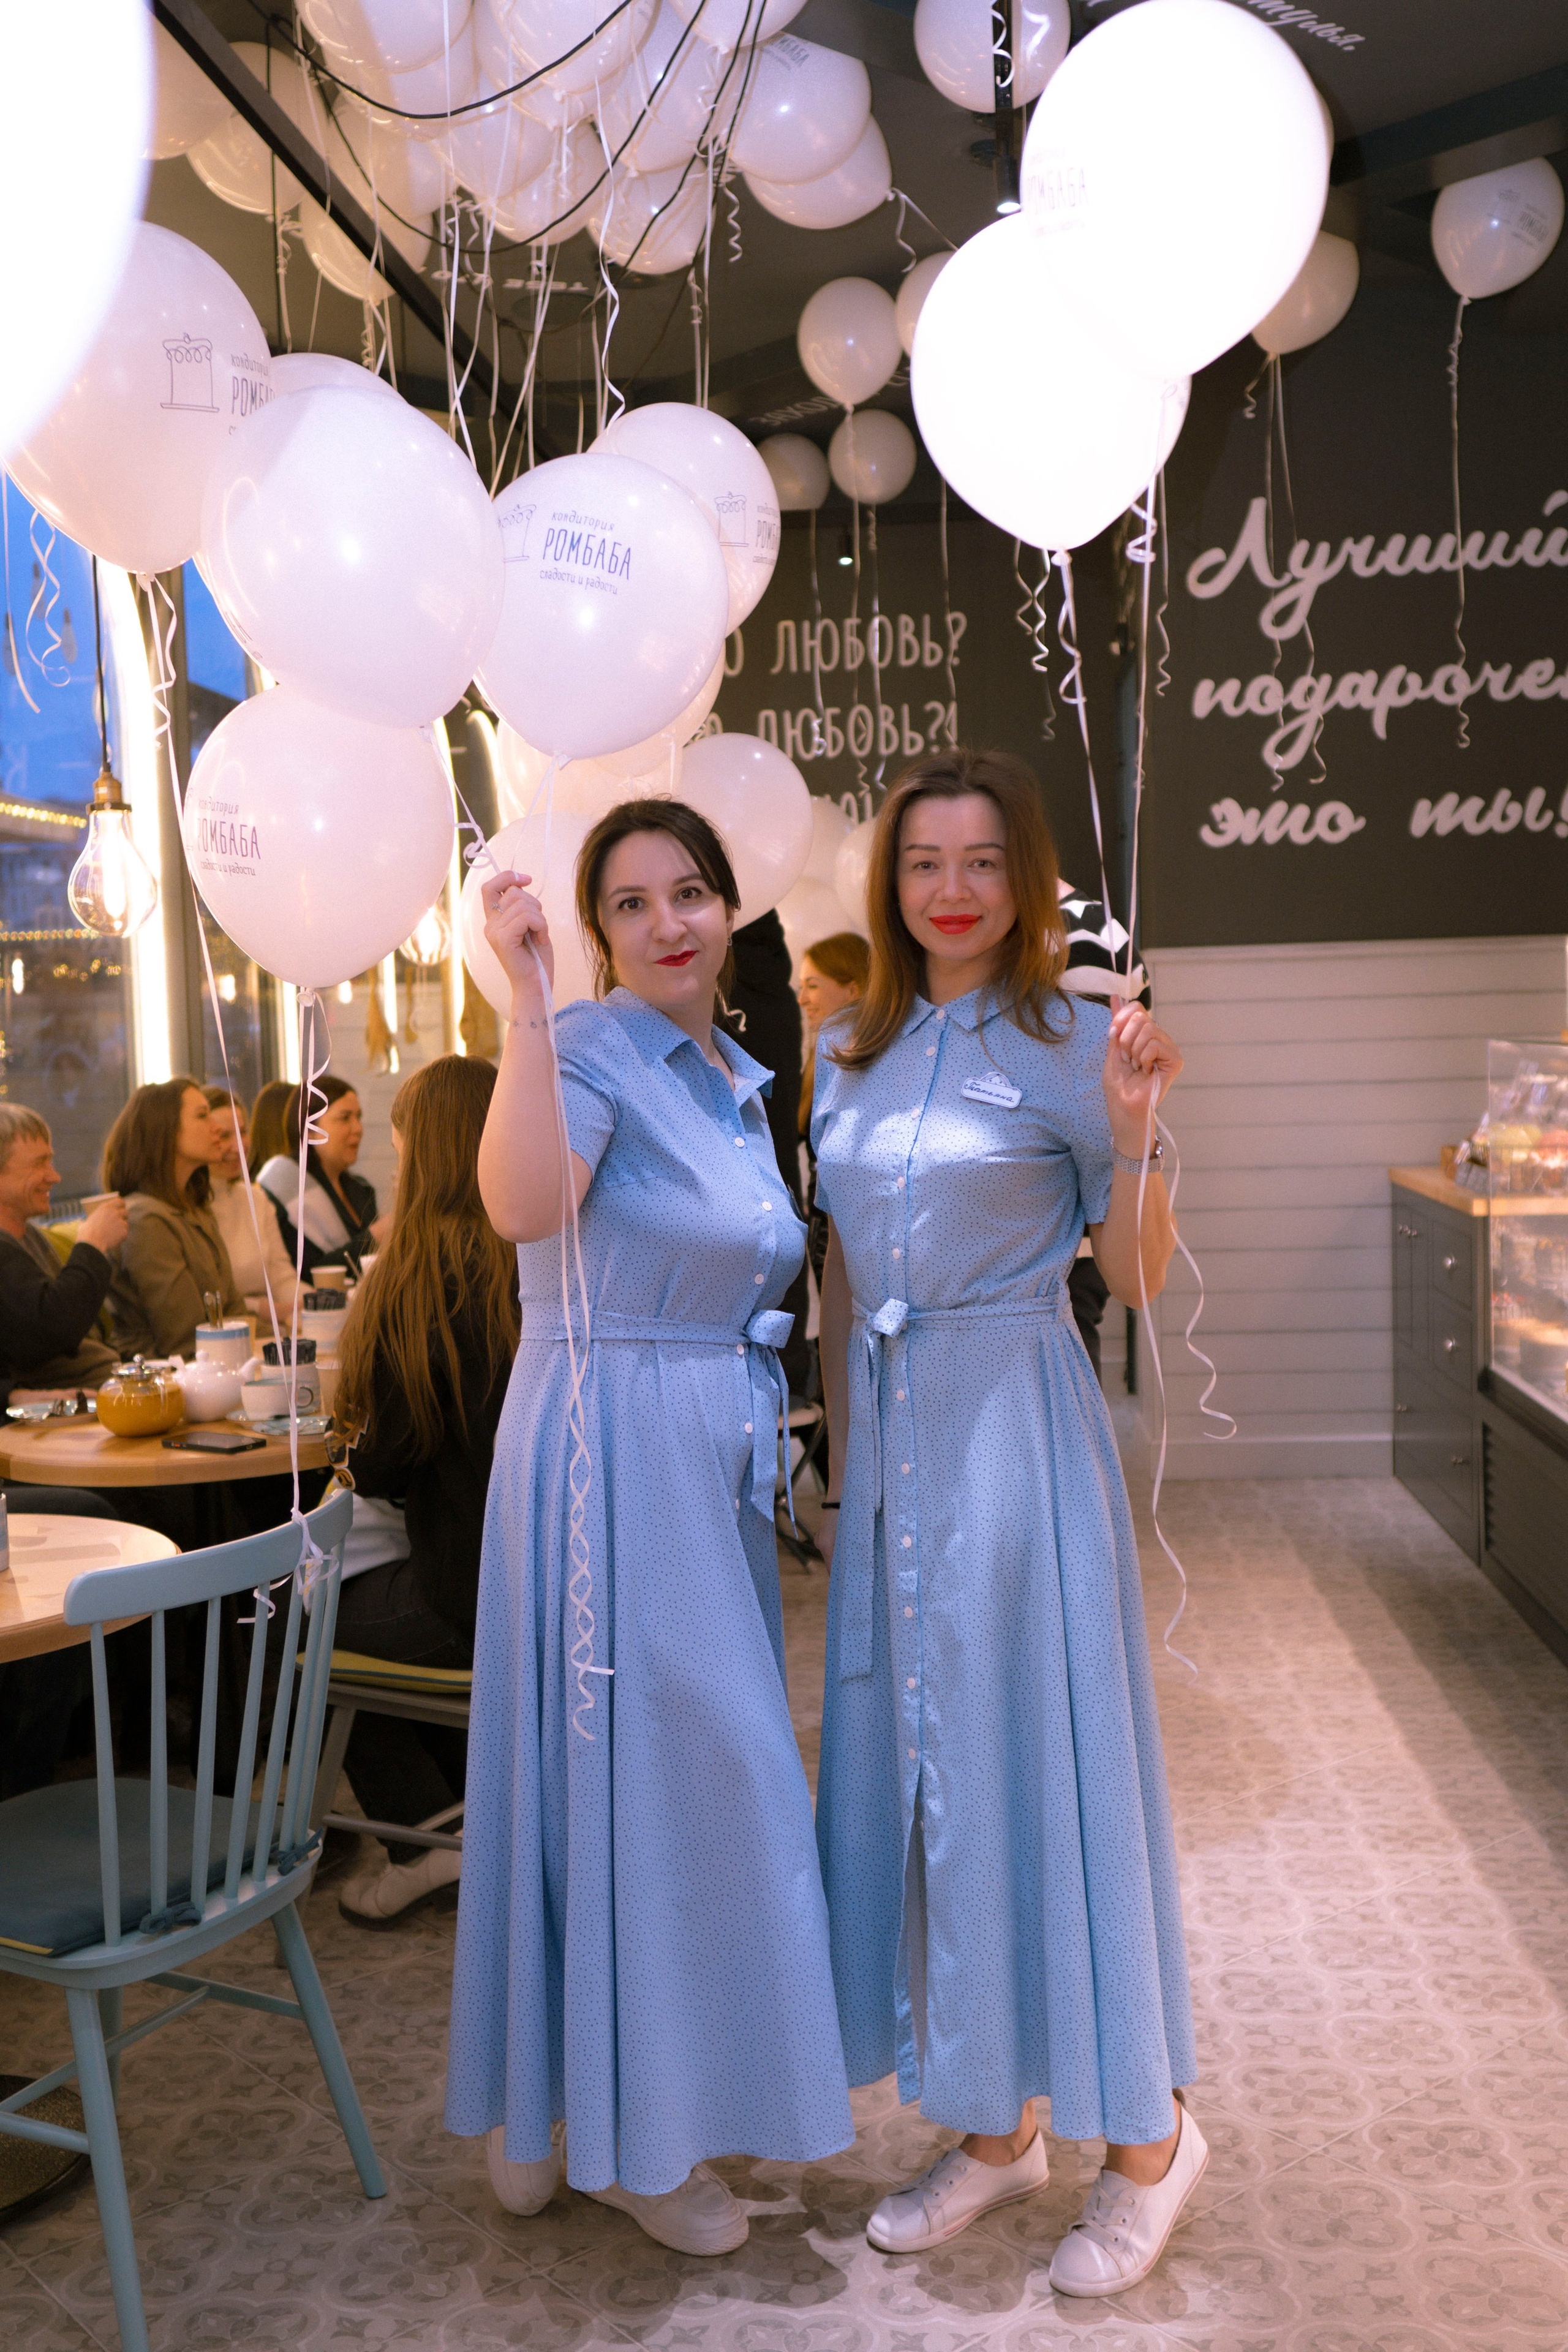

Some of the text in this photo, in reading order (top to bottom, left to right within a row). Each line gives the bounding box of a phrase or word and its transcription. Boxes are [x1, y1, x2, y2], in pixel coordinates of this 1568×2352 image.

[552, 510, 614, 531] кондитория
[543, 527, 631, 581] РОМБАБА
[540, 567, 617, 595] сладости и радости
[771, 611, 968, 674] ЛЮБОВЬ?
[1193, 657, 1568, 770] подароче
[197, 818, 261, 859] РОМБАБА
[1199, 797, 1367, 848] это
[228, 862, 255, 876] радости
[964, 1082, 1014, 1102] Татьяна
